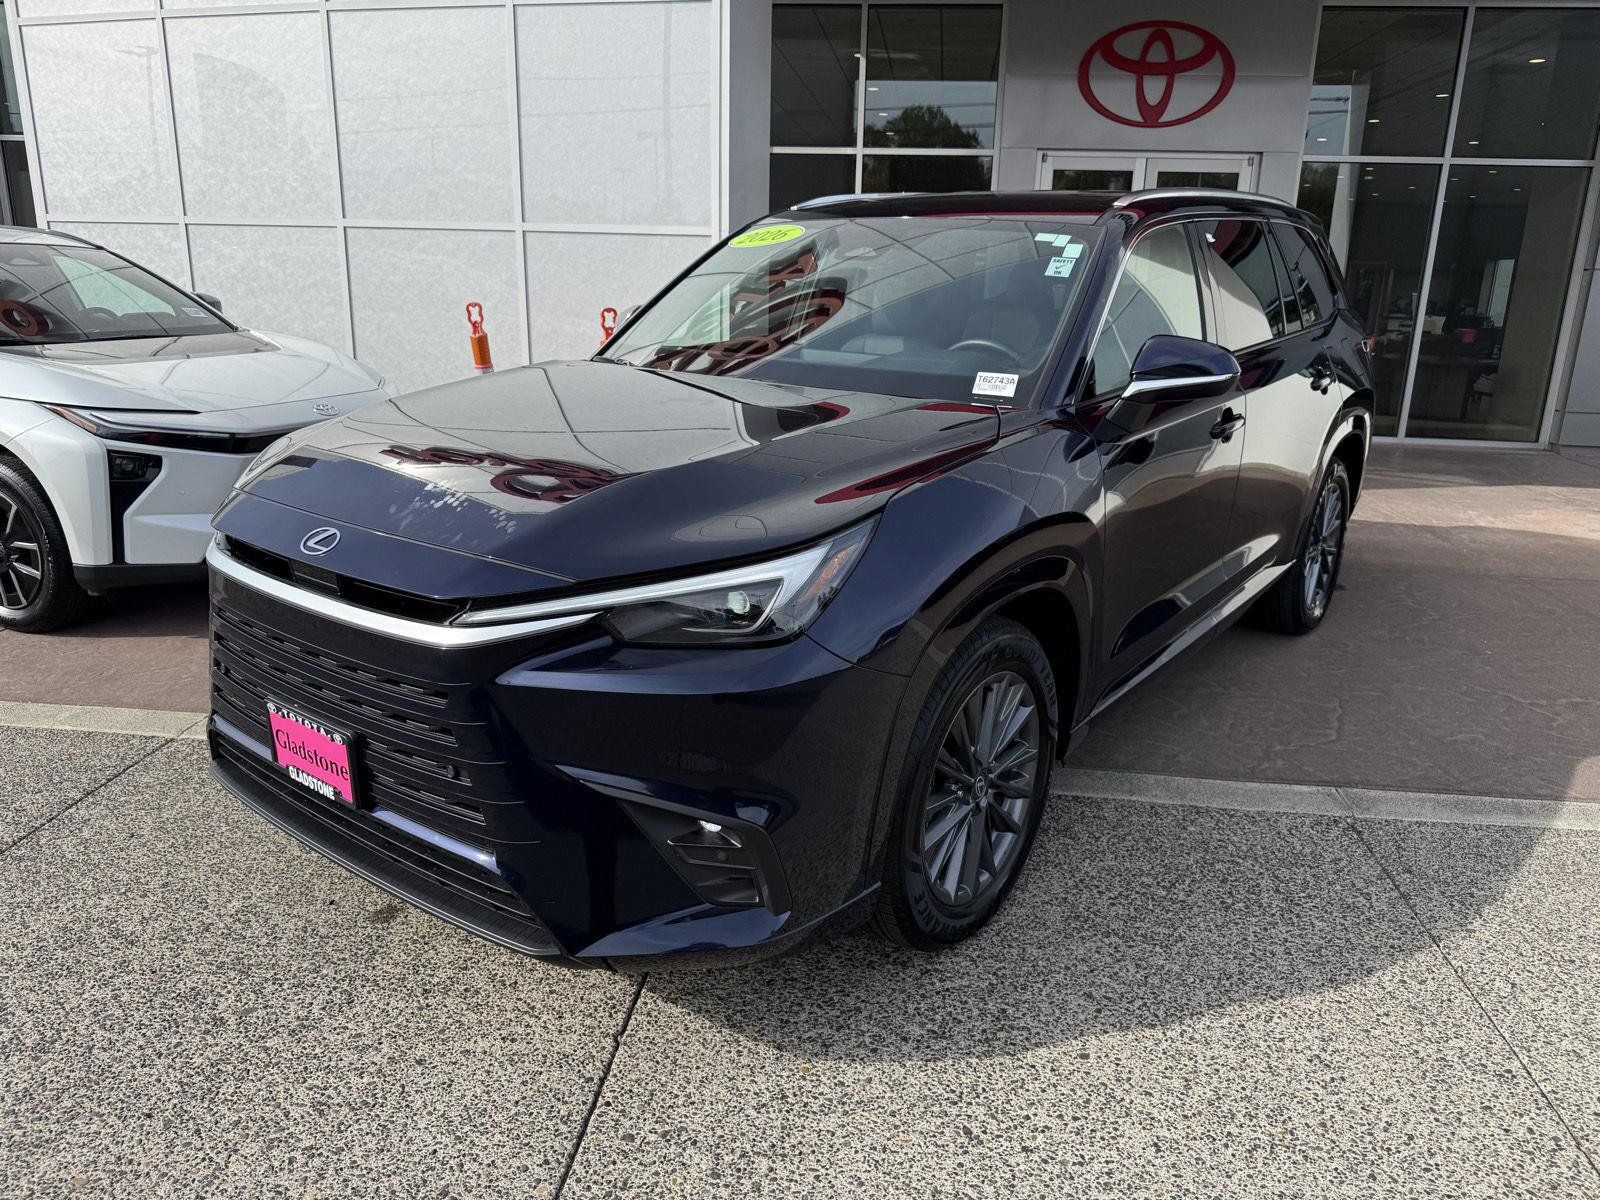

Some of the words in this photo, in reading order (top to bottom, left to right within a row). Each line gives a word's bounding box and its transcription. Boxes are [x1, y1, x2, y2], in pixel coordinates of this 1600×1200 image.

[736, 228, 797, 245] 2026
[978, 375, 1016, 386] T62743A
[282, 709, 326, 736] TOYOTA
[275, 729, 349, 781] Gladstone
[288, 766, 336, 801] GLADSTONE
